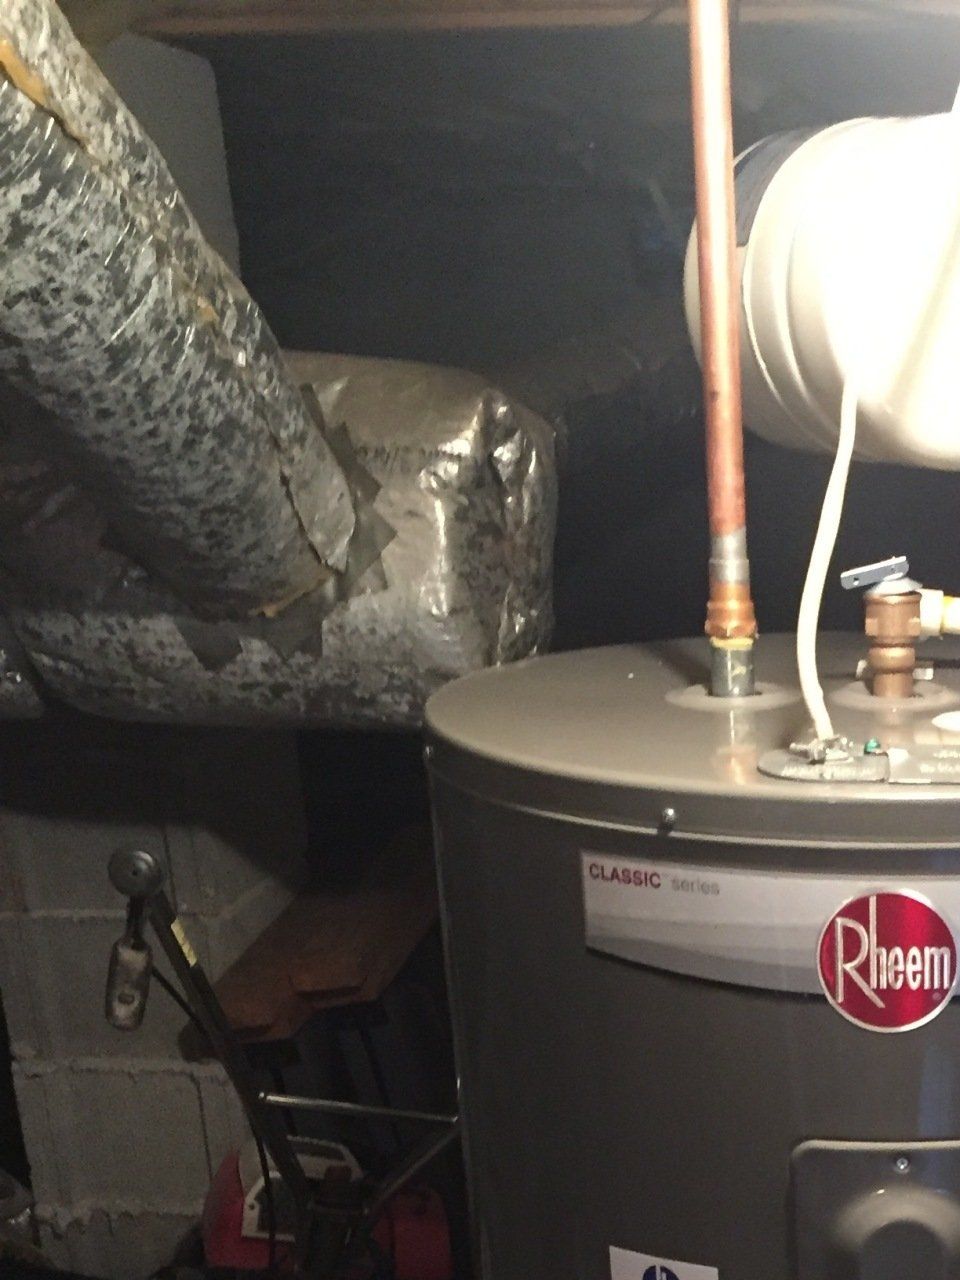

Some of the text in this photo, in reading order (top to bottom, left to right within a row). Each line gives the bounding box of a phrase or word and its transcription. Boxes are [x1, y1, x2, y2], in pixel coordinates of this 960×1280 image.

[589, 863, 721, 896] CLASSIC series
[834, 895, 951, 1009] Rheem
